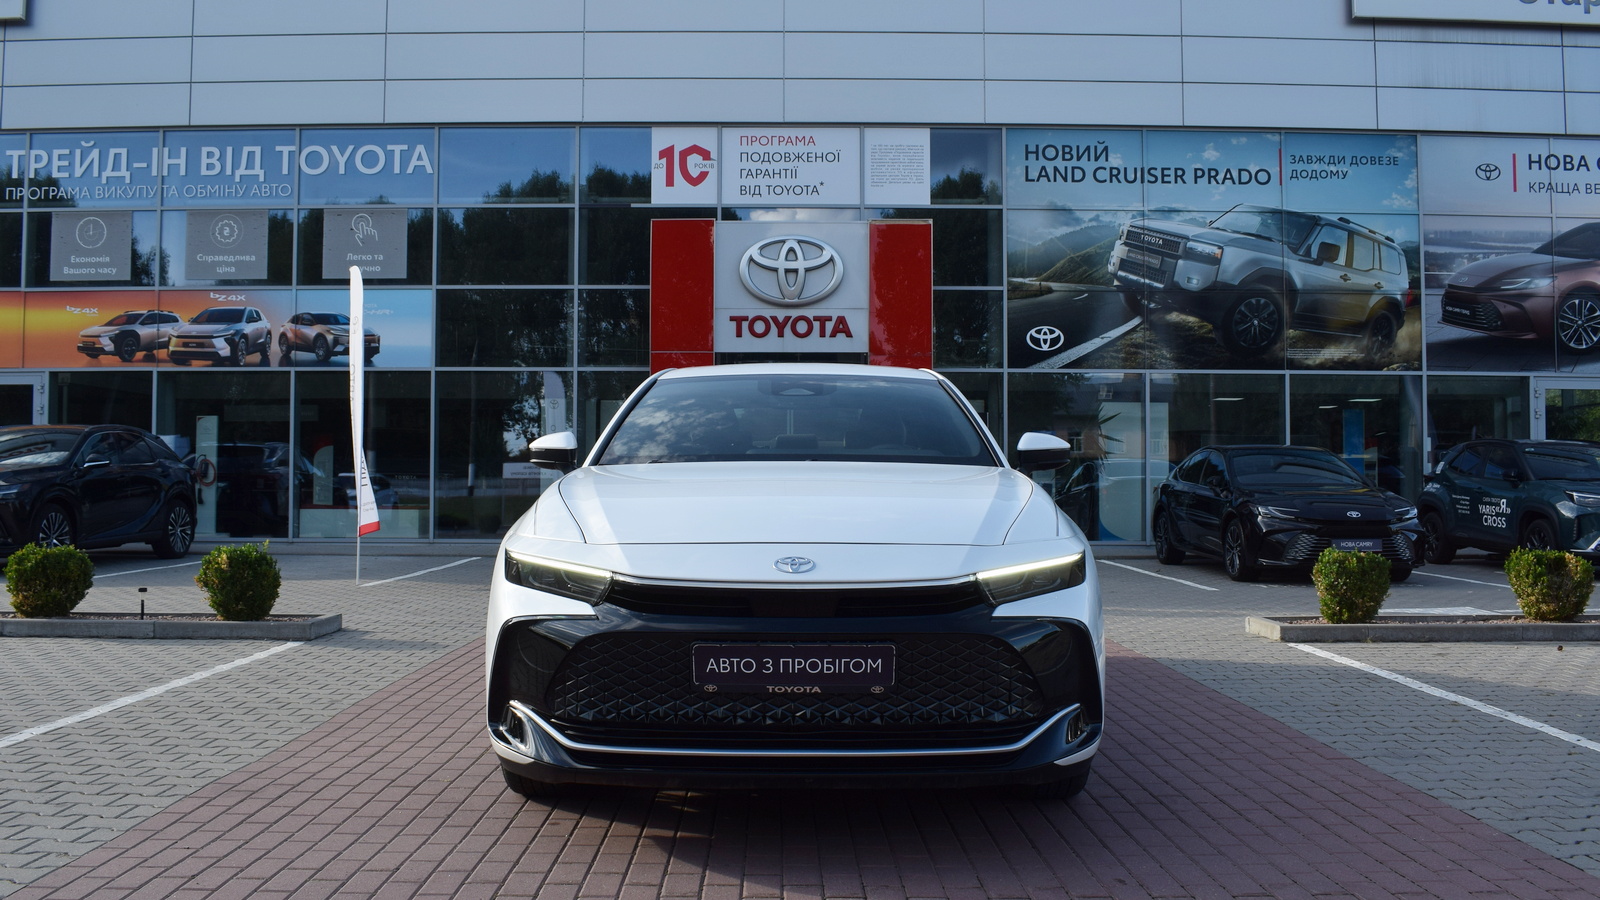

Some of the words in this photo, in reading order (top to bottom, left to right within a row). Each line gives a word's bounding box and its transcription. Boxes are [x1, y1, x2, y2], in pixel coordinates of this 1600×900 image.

[739, 135, 817, 147] ПРОГРАМА
[739, 150, 842, 165] ПОДОВЖЕНОЇ
[1024, 141, 1109, 163] НОВИЙ
[6, 140, 187, 184] ТРЕЙД-ІН
[200, 146, 265, 182] ВІД
[275, 144, 434, 176] TOYOTA
[653, 162, 664, 170] ДО
[1289, 154, 1346, 167] ЗАВЖДИ
[1349, 155, 1400, 168] ДОВЕЗЕ
[1528, 153, 1591, 172] НОВА
[739, 166, 799, 180] ГАРАНТІЇ
[1024, 165, 1086, 183] LAND
[1092, 166, 1187, 185] CRUISER
[1193, 168, 1272, 186] PRADO
[1289, 169, 1349, 181] ДОДОМУ
[6, 186, 91, 200] ПРОГРАМА
[95, 185, 158, 199] ВИКУПУ
[162, 184, 179, 198] ТА
[183, 184, 247, 198] ОБМІНУ
[250, 183, 292, 197] АВТО
[739, 185, 762, 198] ВІД
[1528, 181, 1581, 197] КРАЩА
[1141, 234, 1163, 245] TOYOTA
[70, 255, 110, 263] Економія
[196, 253, 256, 264] Справедлива
[346, 252, 372, 261] Легко
[374, 253, 384, 261] та
[63, 266, 96, 275] Вашого
[97, 267, 117, 275] часу
[216, 265, 236, 275] ціна
[729, 314, 854, 339] TOYOTA
[1478, 504, 1496, 516] YARIS
[1482, 514, 1507, 529] CROSS
[706, 658, 756, 673] АВТО
[762, 658, 774, 673] З
[779, 658, 882, 673] ПРОБІГОМ
[766, 685, 822, 694] TOYOTA
